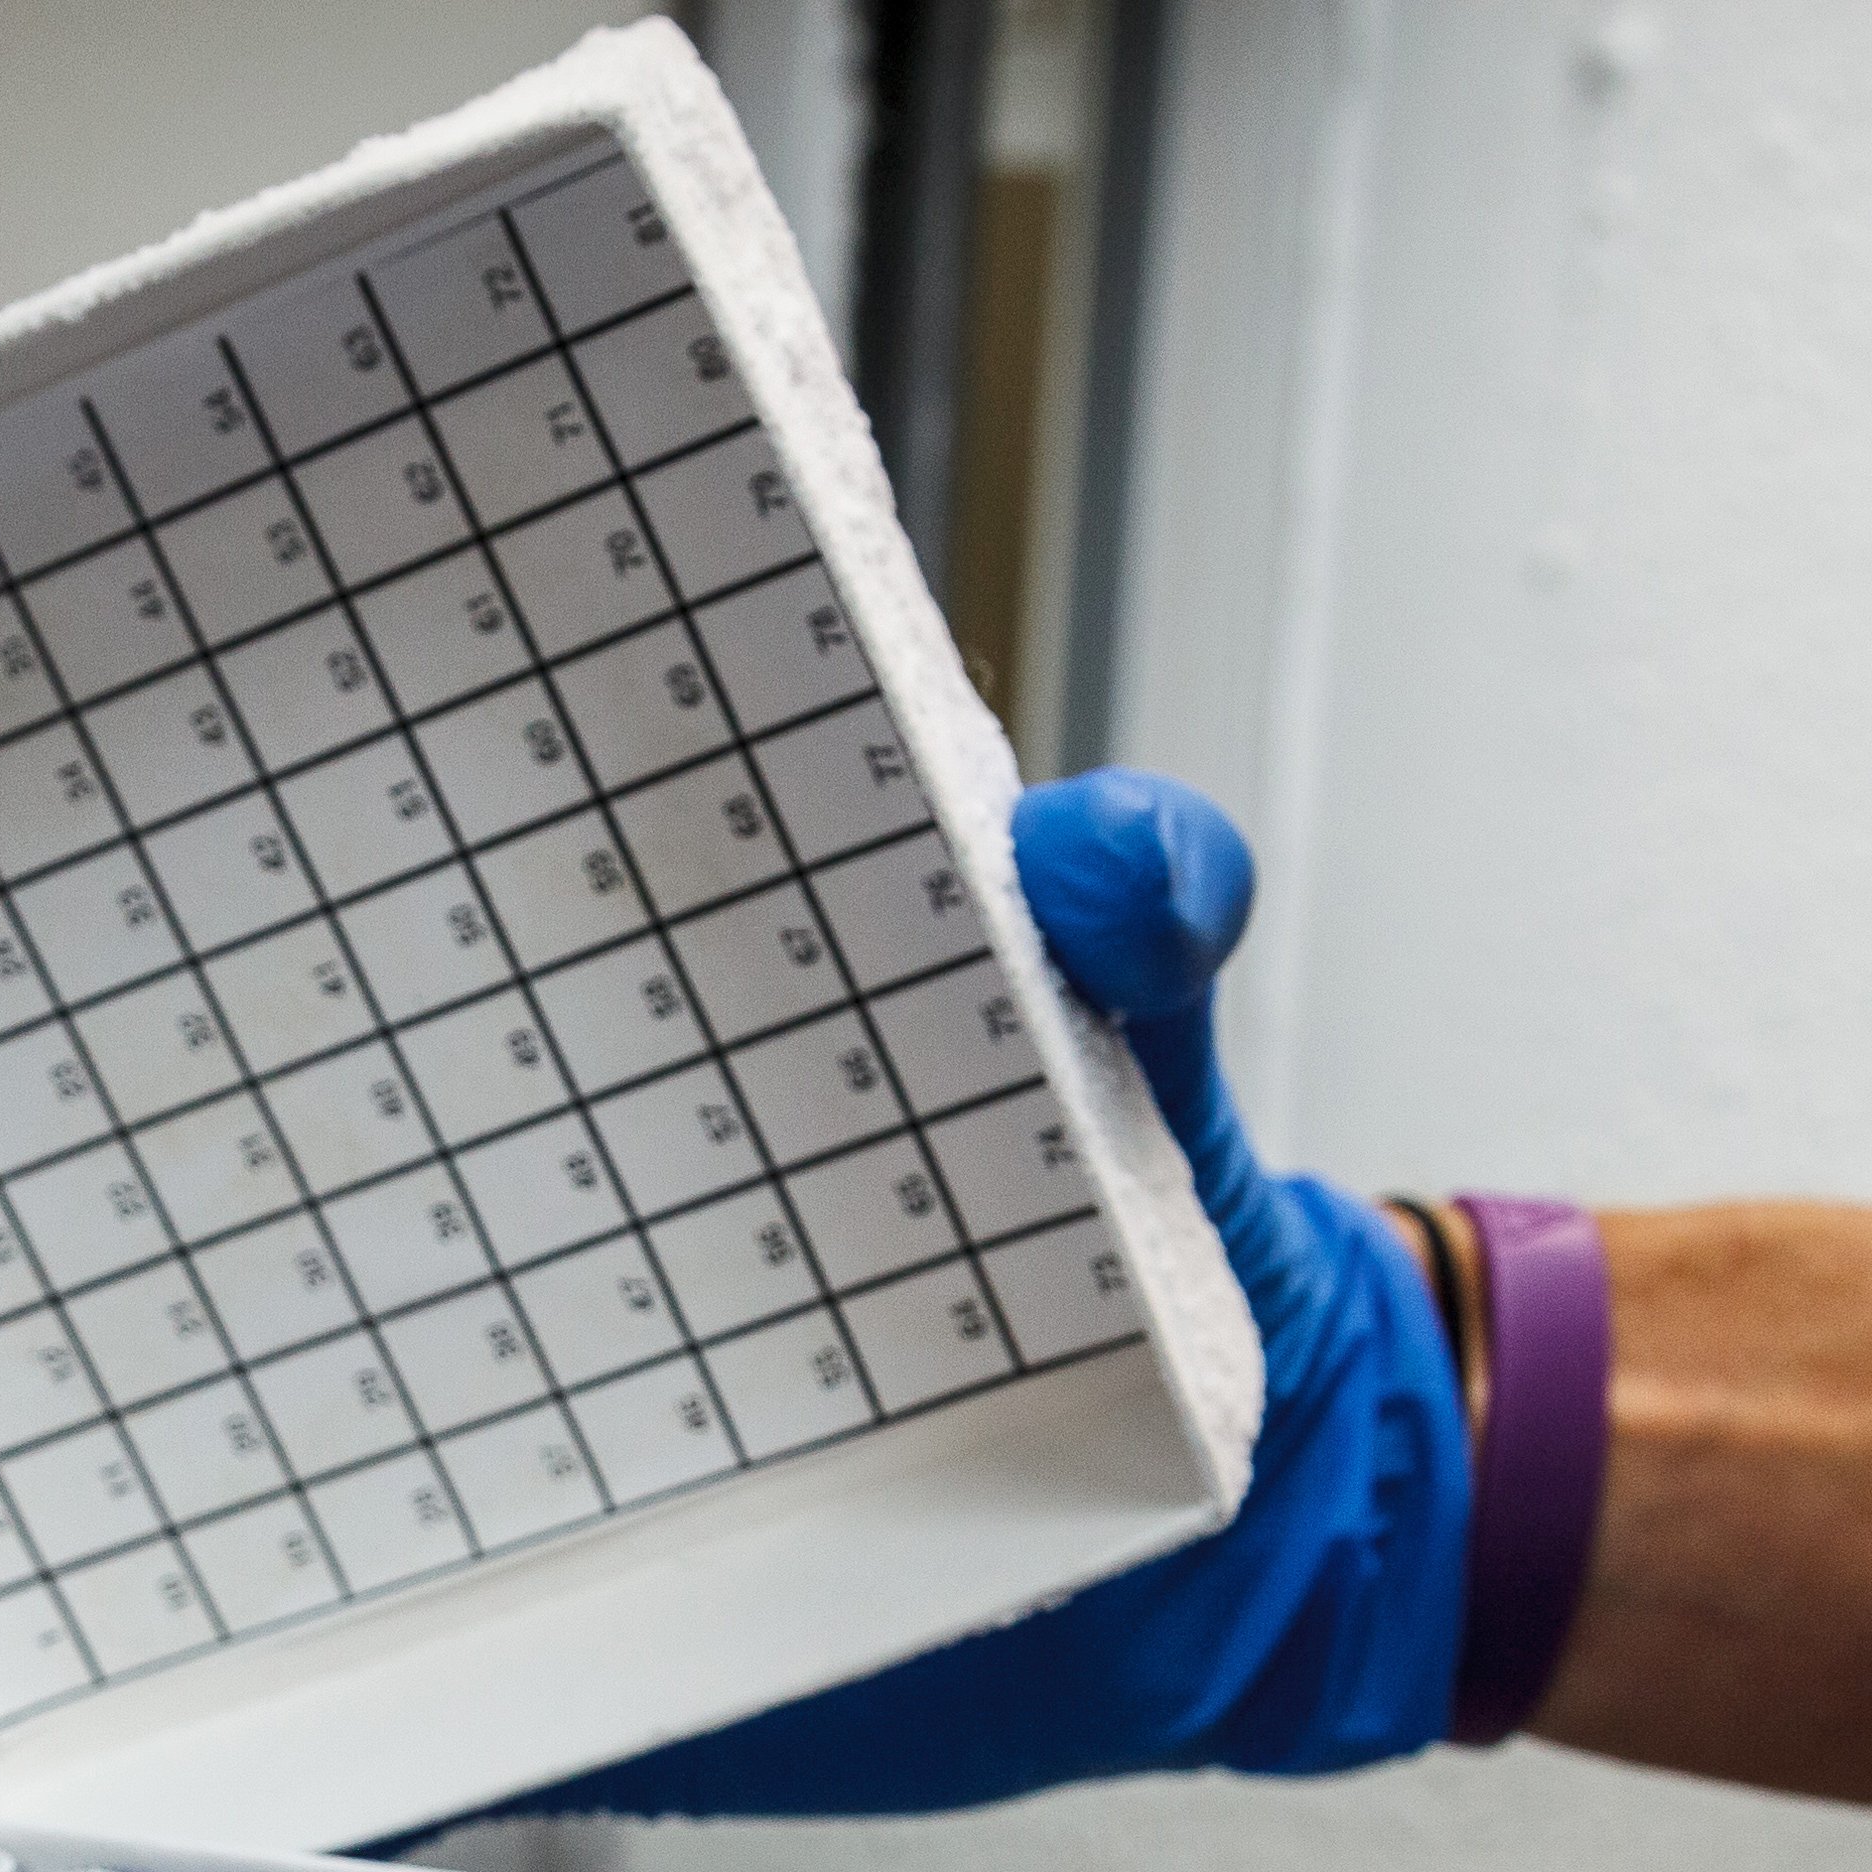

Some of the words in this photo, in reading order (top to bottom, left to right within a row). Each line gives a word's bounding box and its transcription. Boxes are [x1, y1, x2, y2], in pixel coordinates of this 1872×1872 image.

[624, 200, 669, 249] 81
[479, 262, 525, 312] 72
[339, 322, 384, 374] 63
[686, 334, 731, 384] 80
[200, 385, 247, 436] 54
[542, 399, 586, 447] 71
[65, 446, 106, 494] 45
[401, 460, 446, 506] 62
[746, 468, 789, 519] 79
[263, 516, 309, 567] 53
[602, 526, 648, 578] 70
[128, 577, 167, 622] 44
[463, 591, 506, 636] 61
[804, 604, 849, 655] 78
[323, 647, 369, 695] 52
[663, 661, 707, 711] 69
[188, 702, 228, 748] 43
[522, 717, 566, 767] 60
[54, 758, 98, 805] 34
[861, 742, 907, 788] 77
[385, 777, 430, 823] 51
[720, 791, 765, 841] 68
[249, 833, 289, 874] 42
[580, 847, 626, 897] 59
[115, 883, 158, 930] 33
[920, 867, 963, 916] 76
[445, 901, 489, 949] 50
[777, 926, 823, 969] 67
[311, 959, 348, 999] 41
[639, 973, 683, 1022] 58
[177, 1011, 219, 1053] 32
[977, 994, 1020, 1044] 75
[505, 1026, 542, 1070] 49
[837, 1045, 880, 1095] 66
[47, 1058, 91, 1102] 23
[369, 1077, 406, 1120] 40
[695, 1102, 742, 1147] 57
[1034, 1122, 1075, 1170] 74
[237, 1131, 277, 1172] 31
[562, 1150, 600, 1192] 48
[893, 1171, 937, 1219] 65
[428, 1199, 467, 1241] 39
[755, 1221, 797, 1268] 56
[294, 1247, 334, 1290] 30
[1087, 1250, 1129, 1297] 73
[617, 1276, 656, 1314] 47
[484, 1321, 525, 1362] 38
[948, 1295, 990, 1343] 64
[808, 1343, 852, 1392] 55
[677, 1393, 711, 1434] 46
